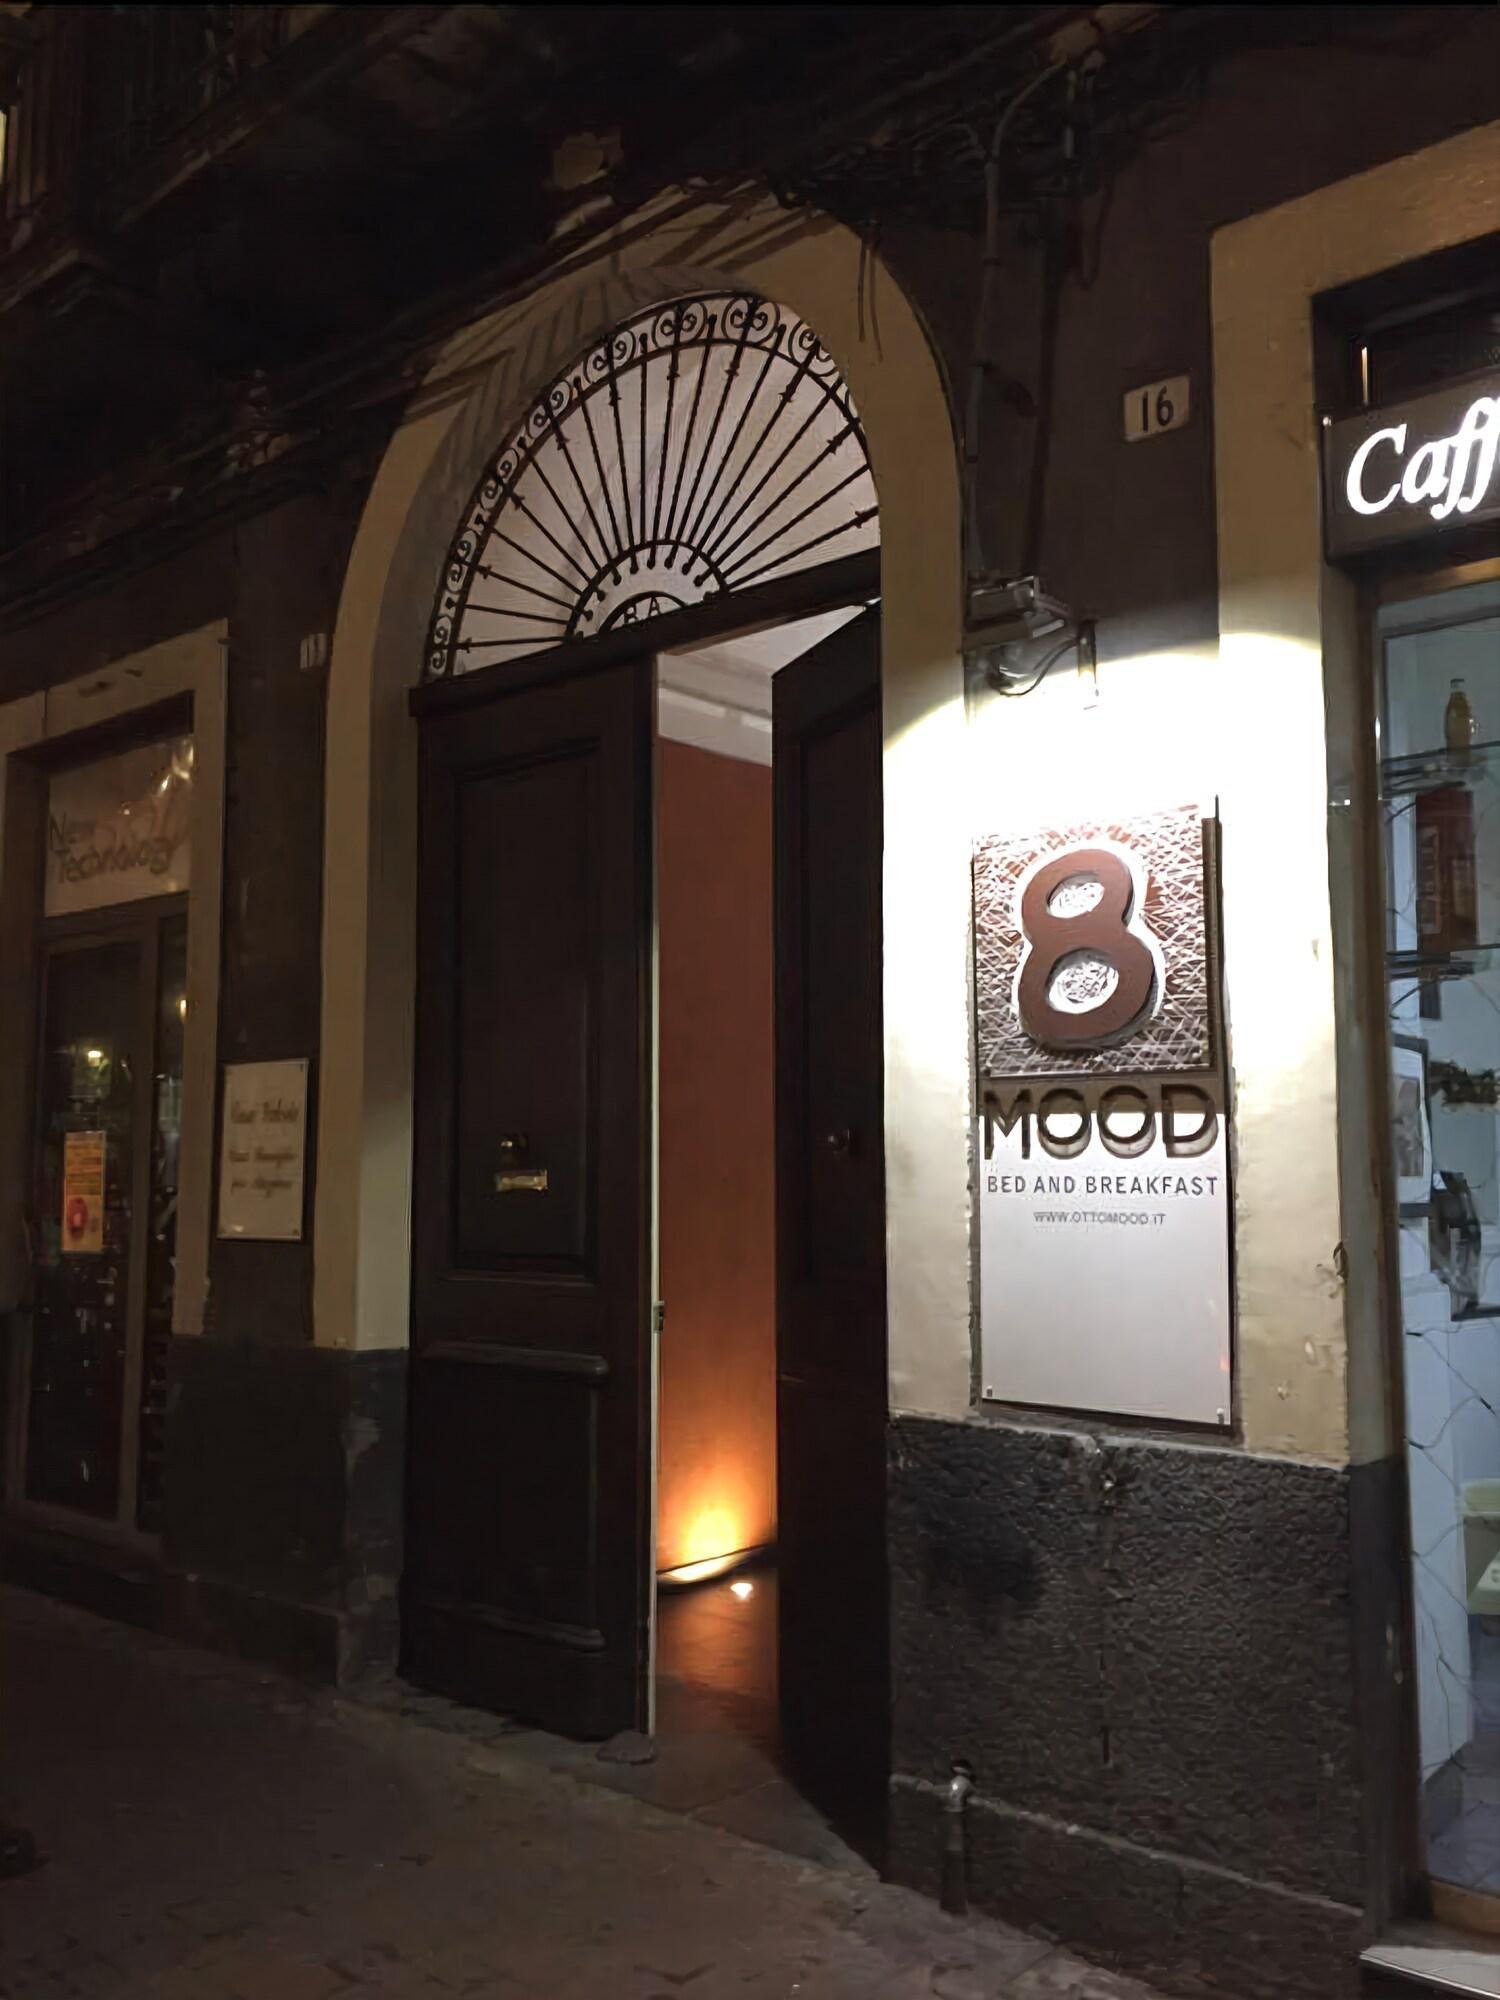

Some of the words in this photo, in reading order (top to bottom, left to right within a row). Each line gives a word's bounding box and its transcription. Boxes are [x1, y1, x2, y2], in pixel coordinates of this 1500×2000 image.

[1137, 385, 1176, 433] 16
[1018, 847, 1156, 1051] 8
[983, 1083, 1219, 1160] MOOD
[987, 1175, 1027, 1194] BED
[1033, 1175, 1077, 1195] AND
[1085, 1175, 1219, 1197] BREAKFAST
